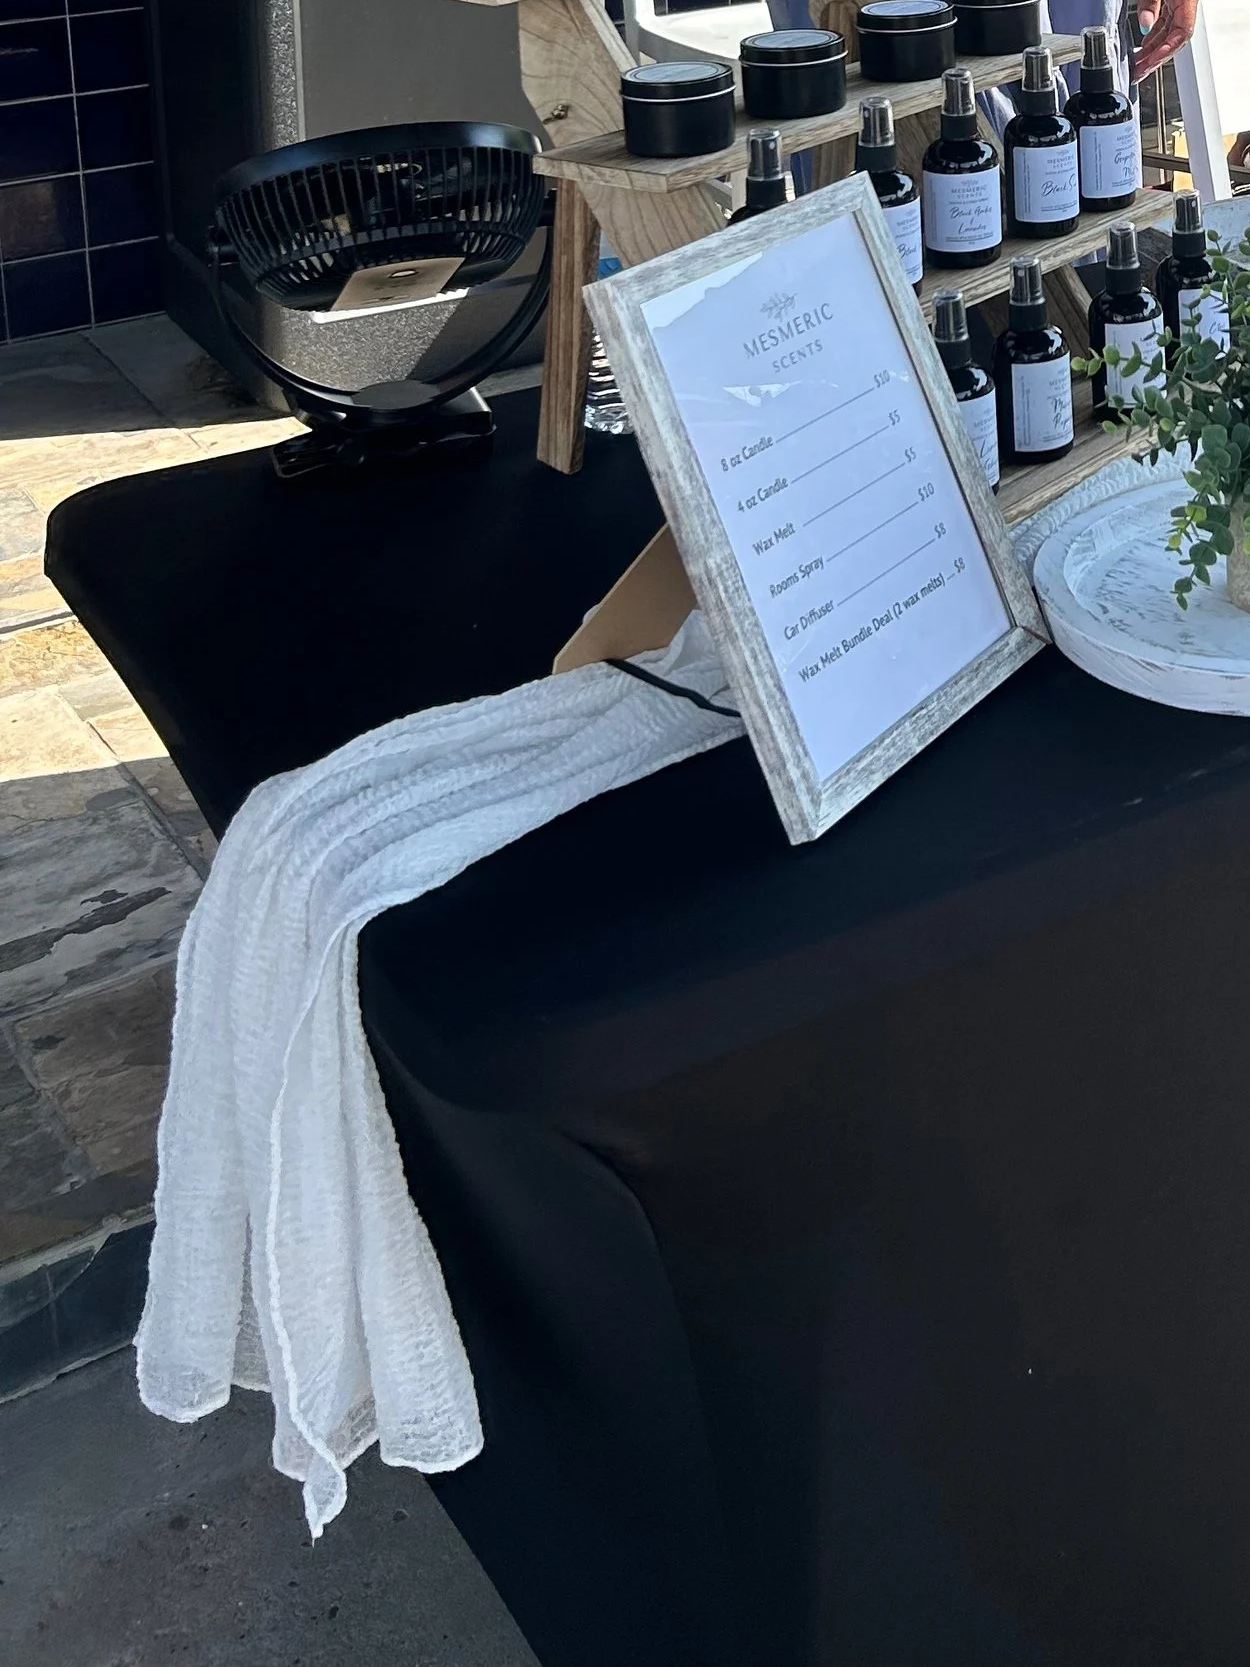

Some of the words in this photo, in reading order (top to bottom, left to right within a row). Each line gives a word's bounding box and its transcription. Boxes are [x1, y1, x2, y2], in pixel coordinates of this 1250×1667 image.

[743, 302, 834, 359] MESMERIC
[772, 339, 824, 373] SCENTS
[721, 457, 729, 472] 8
[730, 453, 742, 468] oz
[742, 435, 774, 460] Candle
[874, 369, 891, 388] $10
[737, 500, 745, 513] 4
[746, 496, 758, 511] oz
[757, 477, 789, 502] Candle
[888, 409, 901, 426] $5
[752, 537, 774, 556] Wax
[773, 522, 796, 542] Melt
[904, 446, 917, 463] $5
[769, 572, 800, 598] Rooms
[798, 556, 825, 579] Spray
[917, 482, 935, 502] $10
[783, 623, 800, 641] Car
[799, 599, 835, 630] Diffuser
[934, 522, 947, 539] $8
[797, 662, 822, 683] Wax
[819, 646, 843, 669] Melt
[841, 625, 873, 654] Bundle
[872, 609, 894, 632] Deal
[893, 602, 904, 620] (2
[902, 591, 921, 610] wax
[919, 573, 946, 599] melts)
[954, 556, 966, 573] $8
